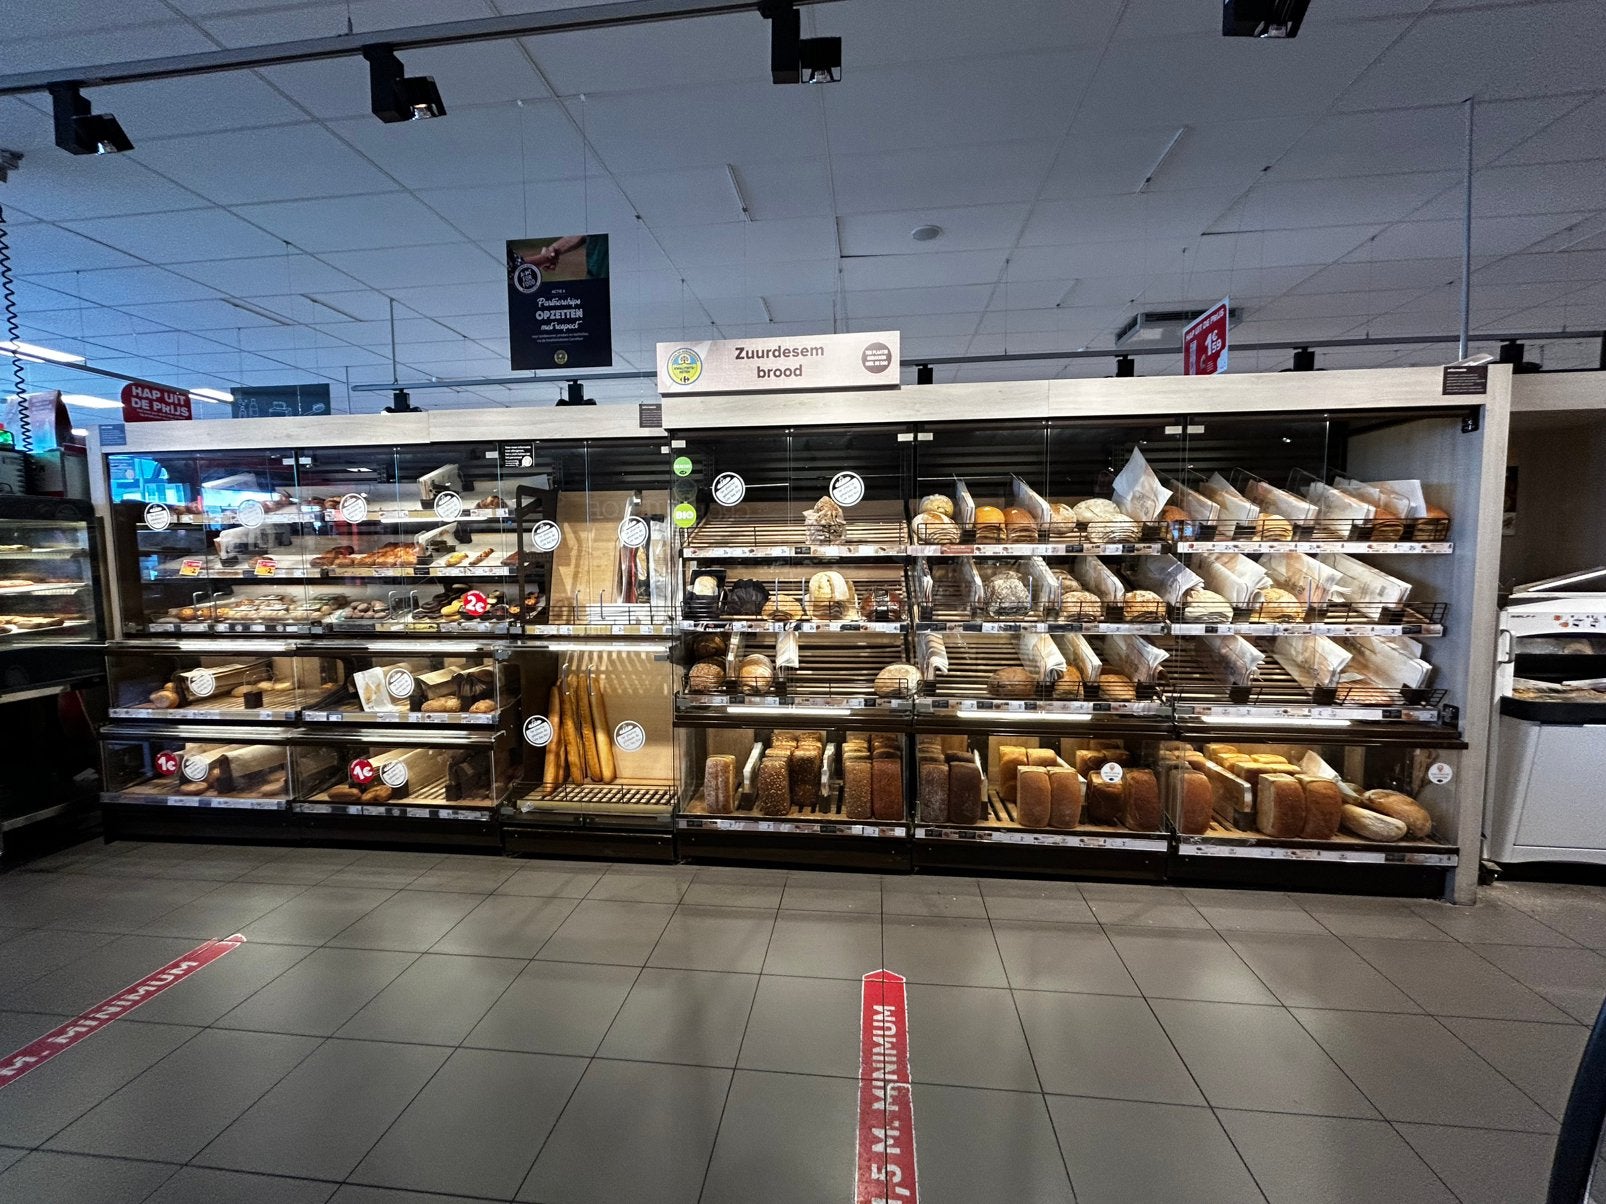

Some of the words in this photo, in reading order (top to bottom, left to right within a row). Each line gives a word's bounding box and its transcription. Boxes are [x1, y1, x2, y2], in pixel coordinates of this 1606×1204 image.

[535, 308, 584, 320] OPZETTEN
[735, 344, 825, 361] Zuurdesem
[756, 364, 803, 379] brood
[131, 385, 161, 400] HAP
[163, 391, 186, 405] UIT
[131, 397, 150, 410] DE
[152, 401, 190, 417] PRIJS
[675, 510, 694, 520] BIO
[157, 756, 177, 771] 1€
[47, 960, 199, 1044] MINIMUM
[871, 1003, 899, 1112] MINIMUM
